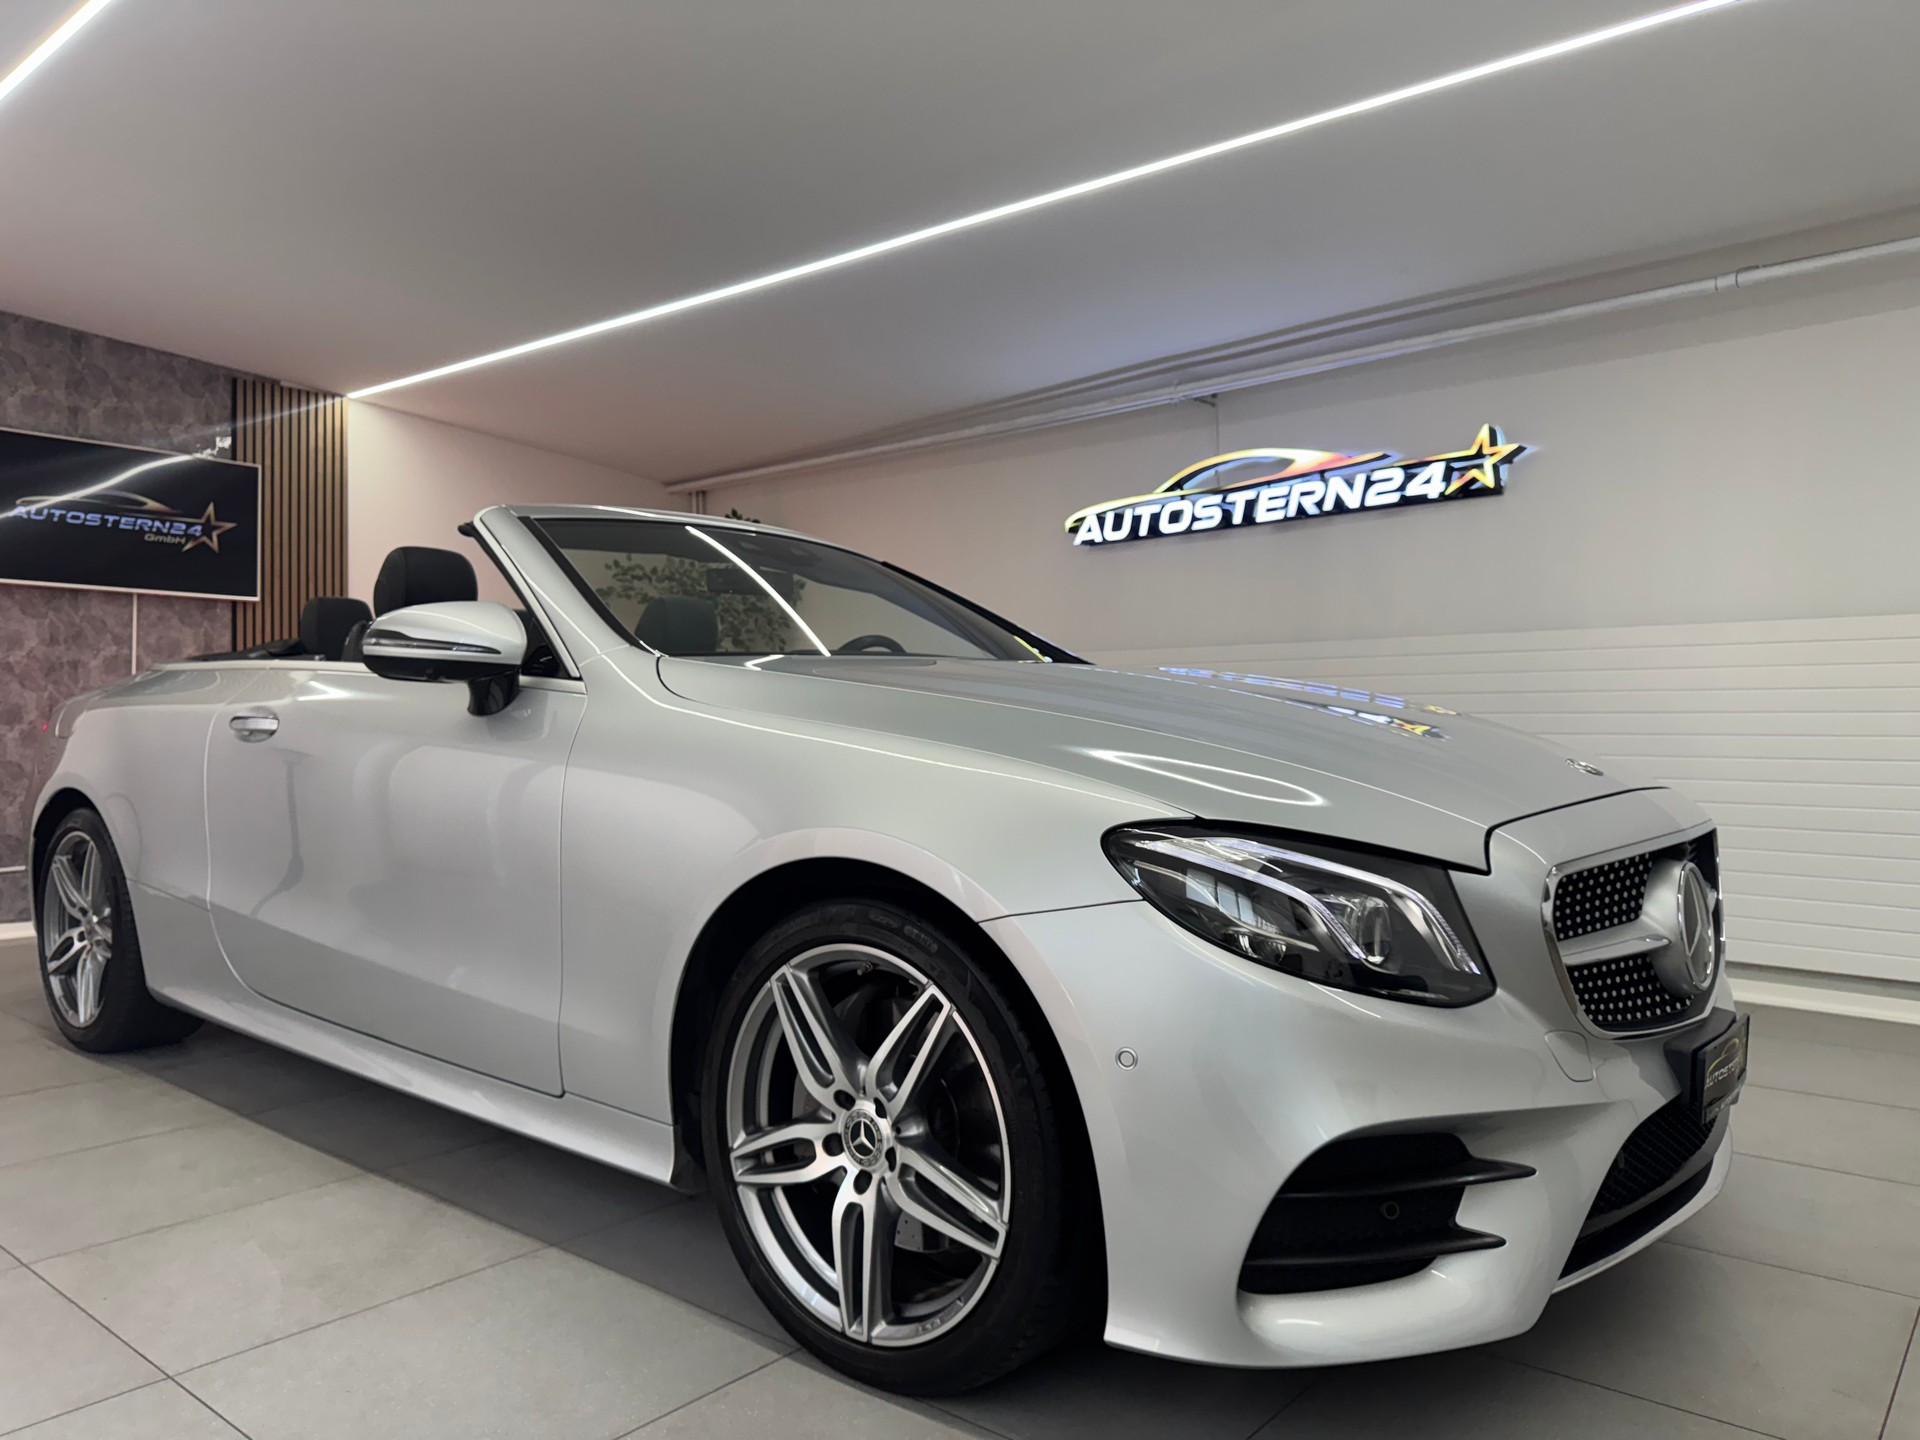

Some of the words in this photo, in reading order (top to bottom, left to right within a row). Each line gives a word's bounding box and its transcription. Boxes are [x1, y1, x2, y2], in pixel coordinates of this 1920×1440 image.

[1073, 461, 1447, 545] AUTOSTERN24
[9, 505, 202, 537] AUTOSTERN24
[144, 533, 186, 544] GmbH
